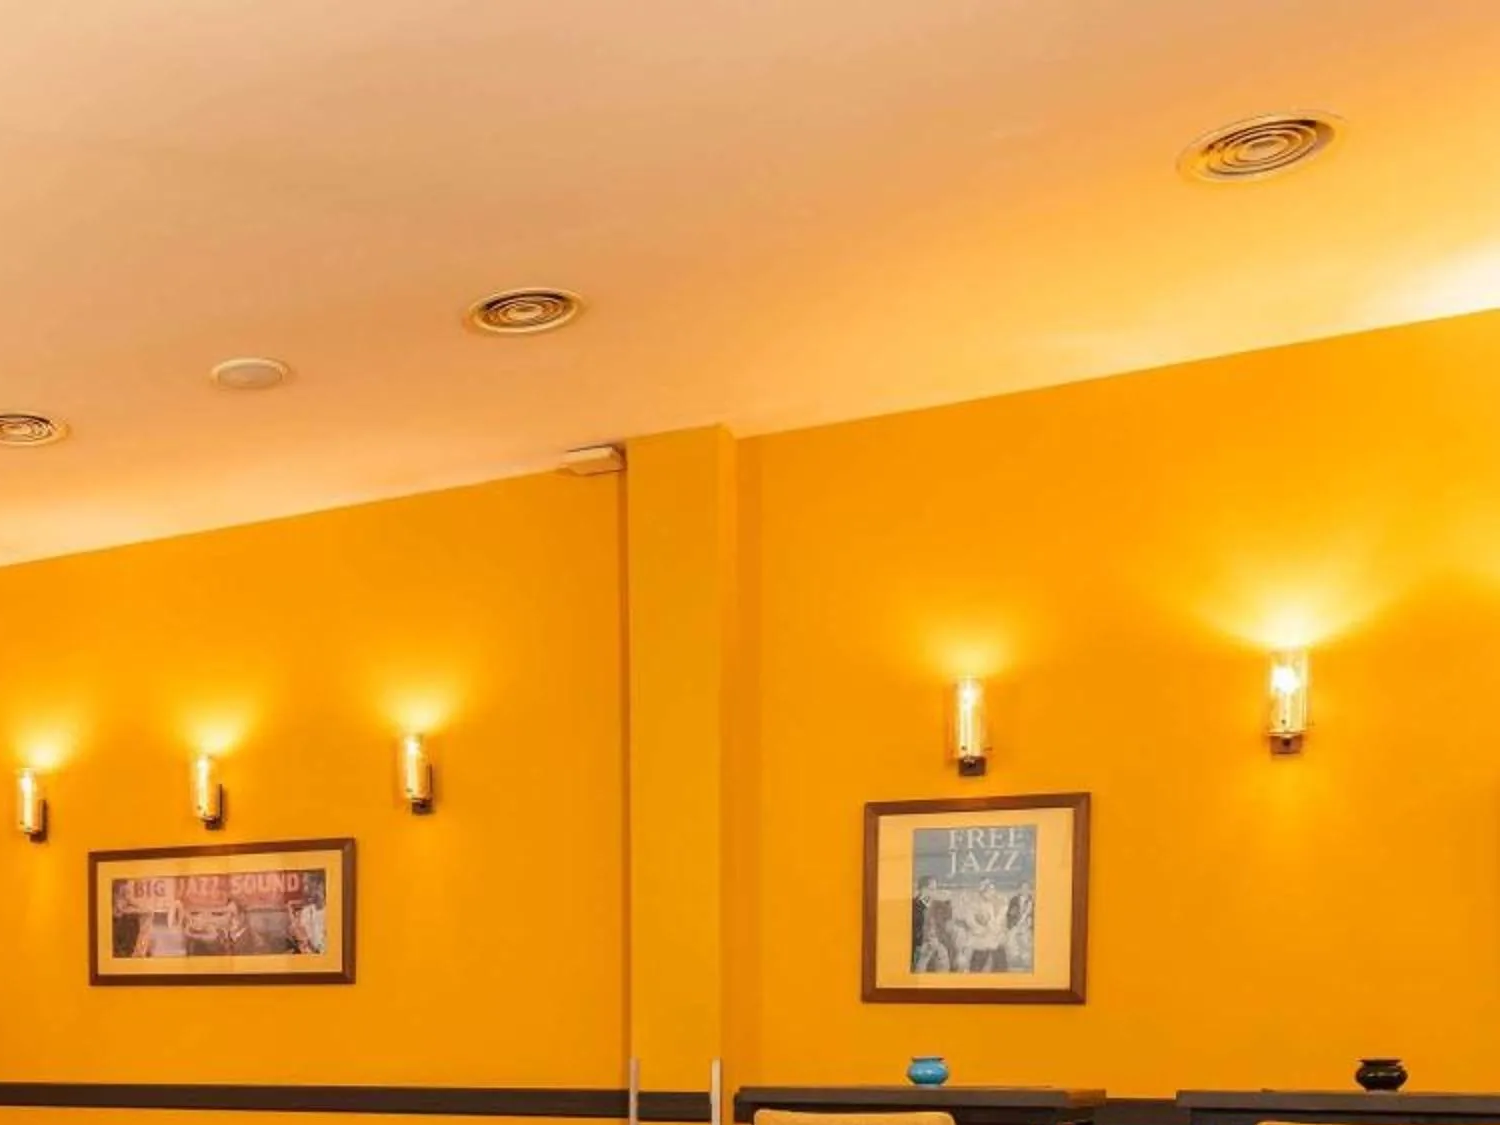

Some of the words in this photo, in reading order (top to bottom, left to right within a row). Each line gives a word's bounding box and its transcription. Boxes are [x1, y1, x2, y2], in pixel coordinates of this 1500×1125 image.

[949, 827, 1026, 850] FREE
[947, 850, 1021, 878] JAZZ
[133, 878, 166, 898] BIG
[179, 874, 221, 896] JAZZ
[232, 870, 300, 894] SOUND
